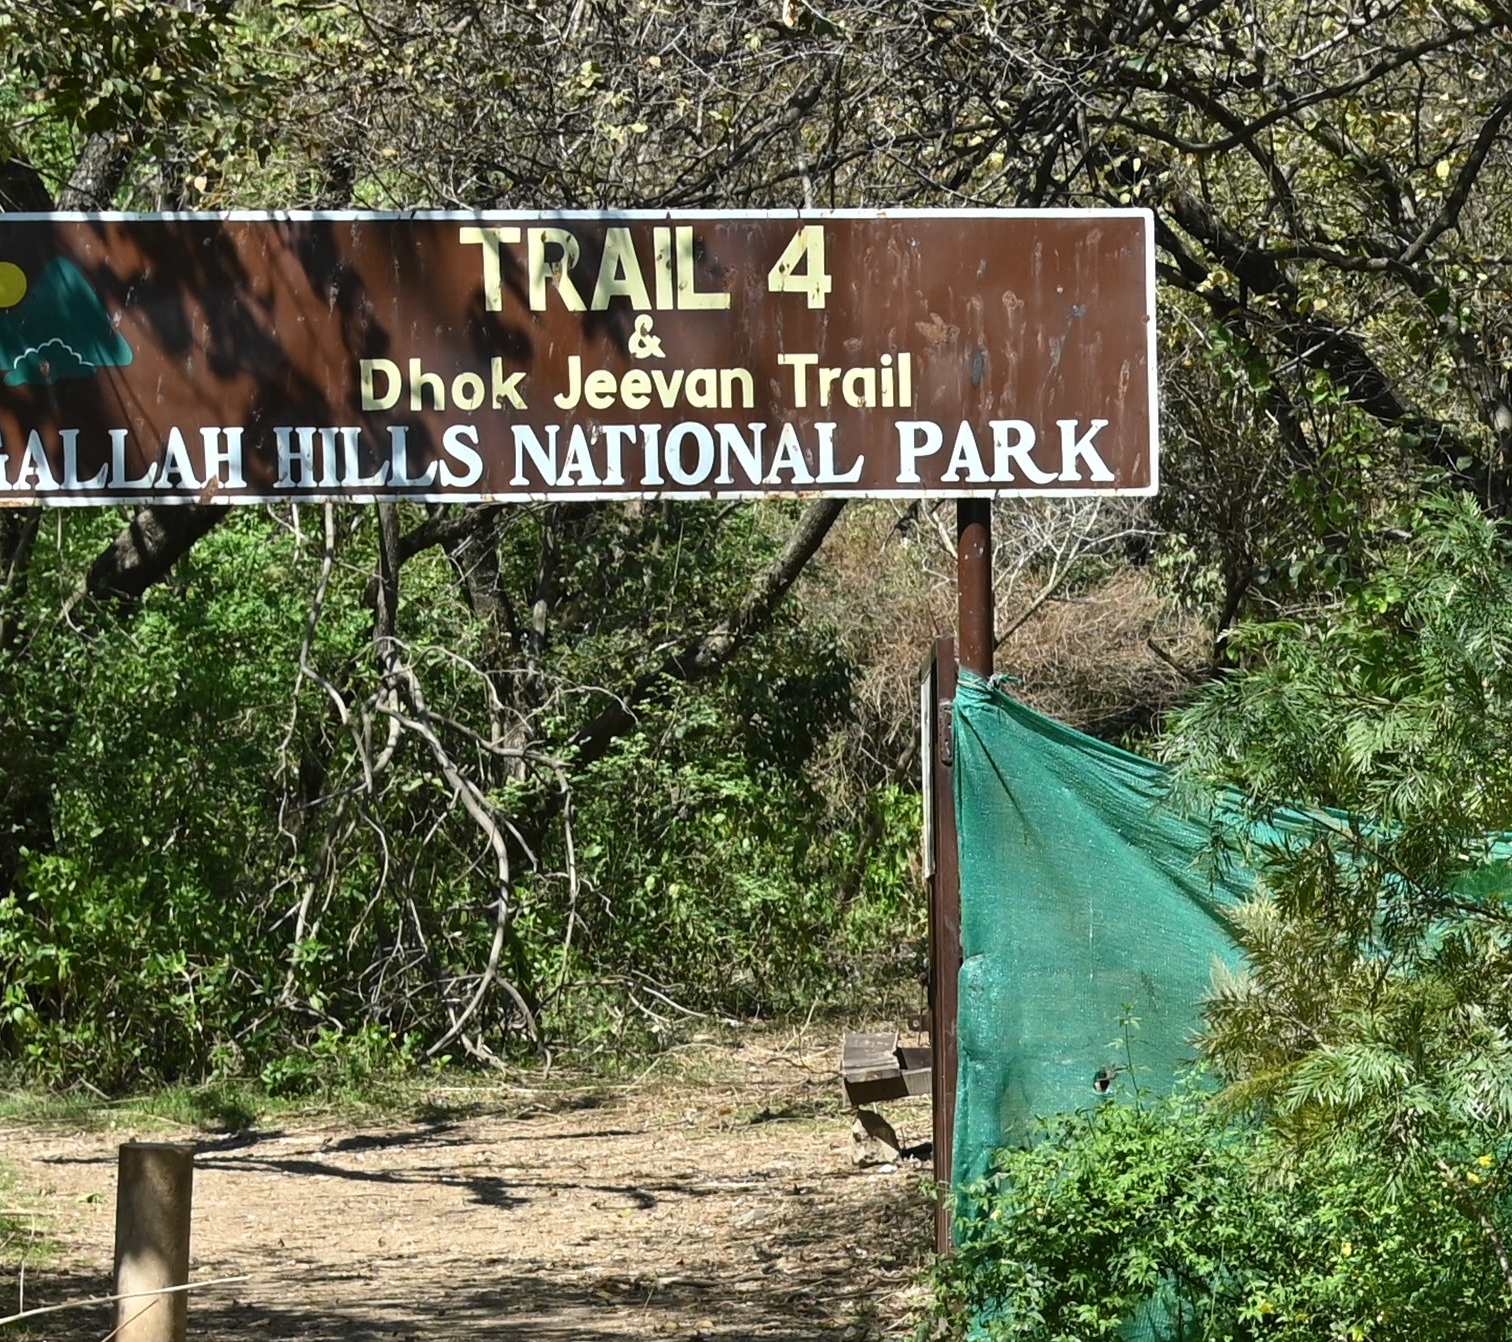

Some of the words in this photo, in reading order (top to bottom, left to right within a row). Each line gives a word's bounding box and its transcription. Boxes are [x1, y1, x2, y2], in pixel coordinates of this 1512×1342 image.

[460, 225, 730, 313] TRAIL
[768, 223, 832, 308] 4
[628, 313, 665, 358] &
[360, 357, 527, 413] Dhok
[552, 352, 754, 413] Jeevan
[777, 352, 912, 410] Trail
[275, 424, 483, 493] HILLS
[510, 422, 864, 487] NATIONAL
[899, 418, 1116, 484] PARK
